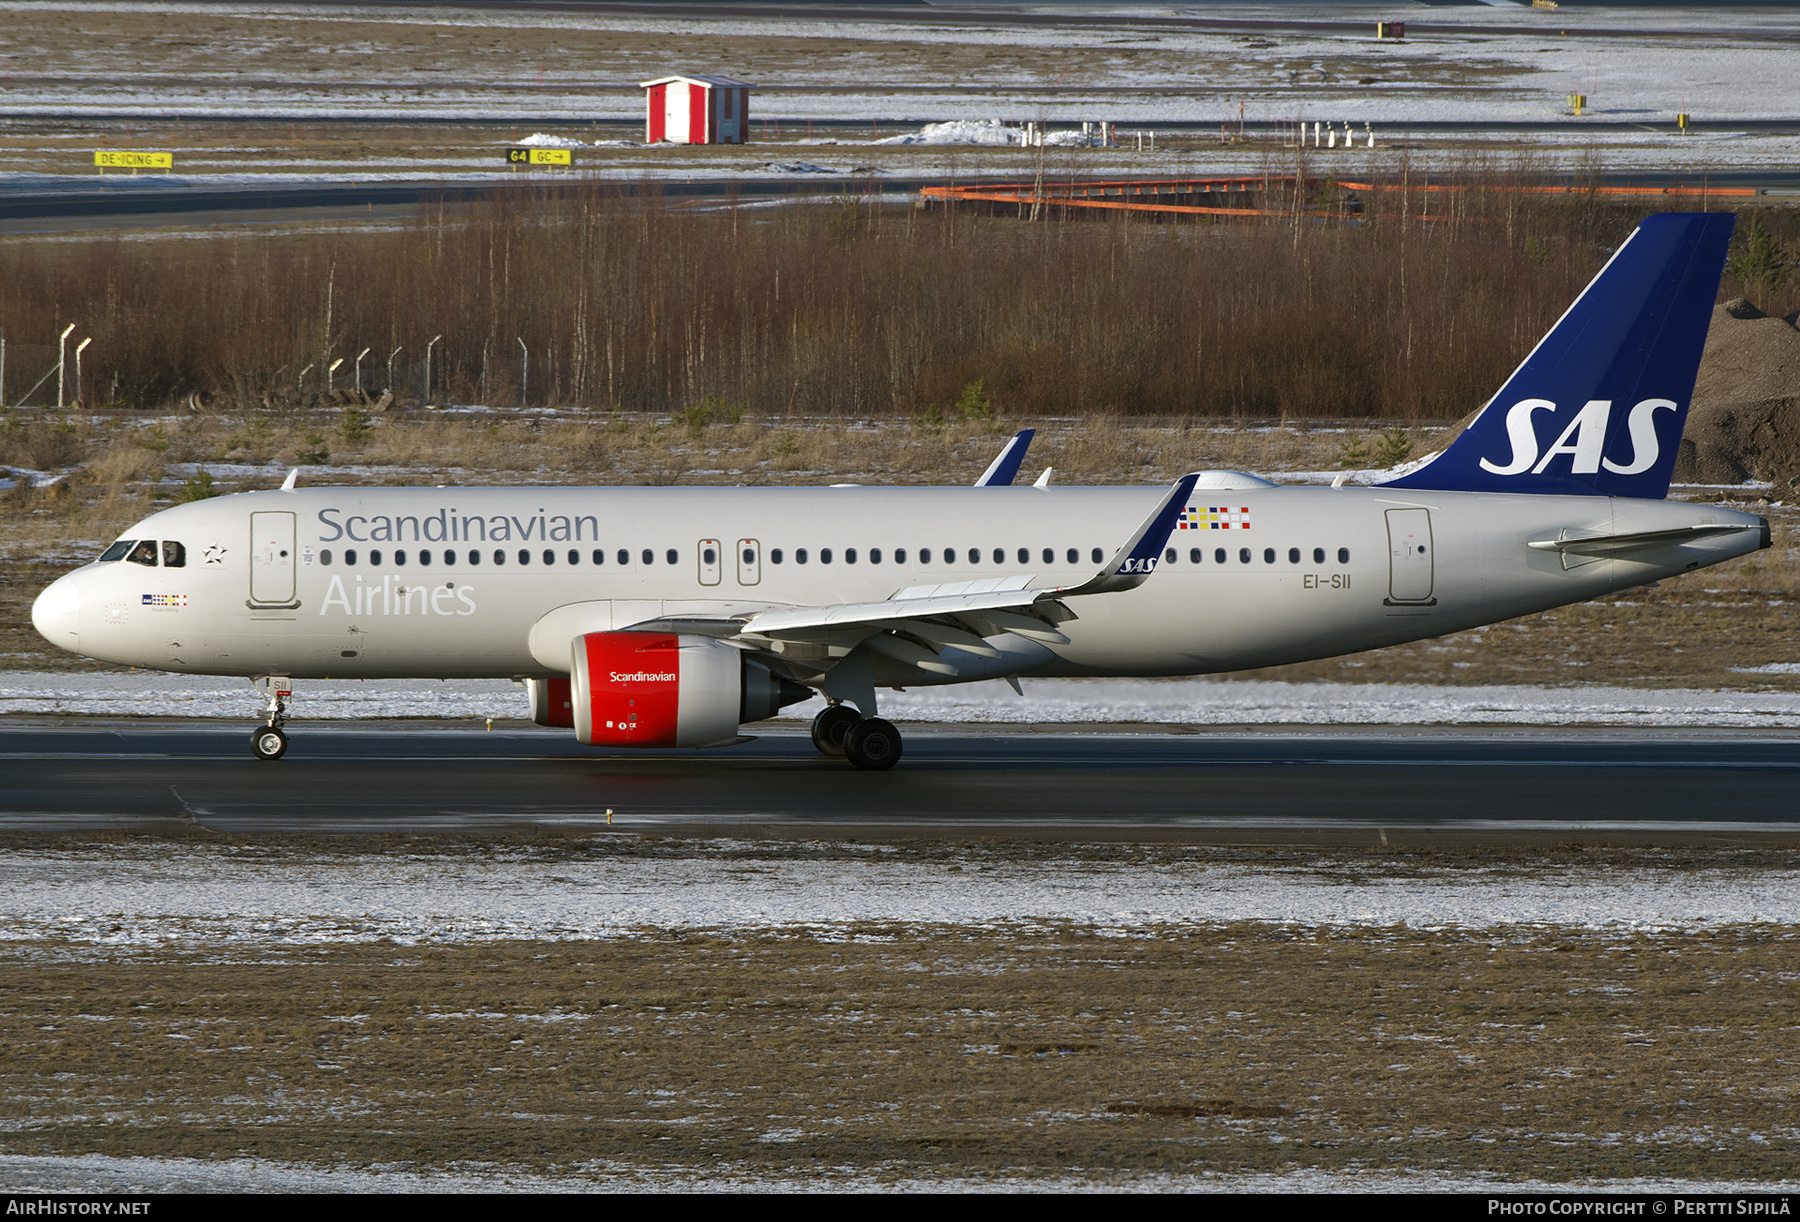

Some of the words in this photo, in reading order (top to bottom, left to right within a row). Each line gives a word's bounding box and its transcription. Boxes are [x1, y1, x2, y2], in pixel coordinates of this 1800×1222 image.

[101, 154, 152, 165] DE-ICING
[510, 150, 527, 162] G4
[537, 151, 552, 162] GC
[1479, 398, 1678, 475] SAS
[317, 508, 599, 543] Scandinavian
[1120, 557, 1157, 573] SAS
[1303, 574, 1351, 589] EI-SII
[319, 574, 477, 616] Airlines
[609, 671, 676, 683] Scandinavian
[273, 680, 287, 690] SII
